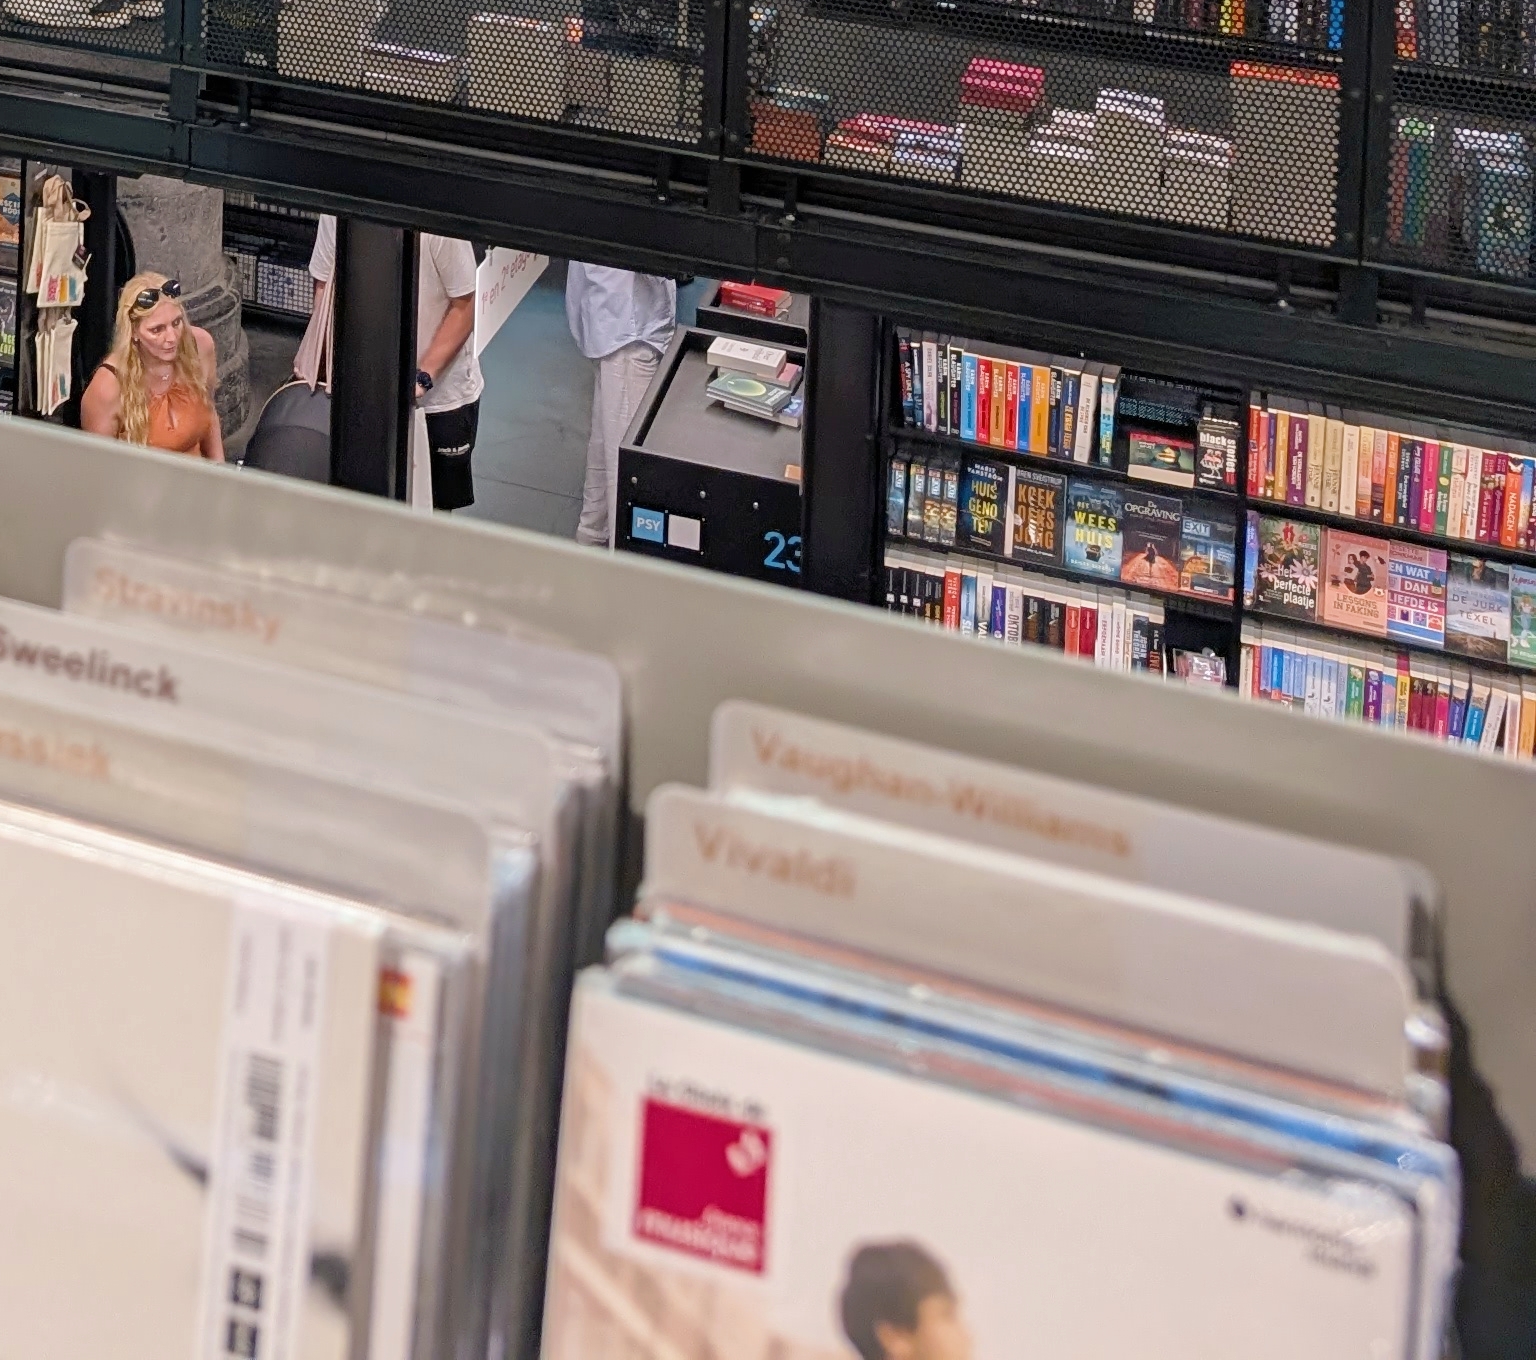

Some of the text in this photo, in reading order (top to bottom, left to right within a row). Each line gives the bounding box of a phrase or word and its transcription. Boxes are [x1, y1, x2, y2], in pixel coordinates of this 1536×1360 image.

[490, 282, 499, 305] en
[1200, 431, 1227, 446] black
[1225, 437, 1237, 474] stories
[971, 479, 998, 498] HUIS
[1018, 483, 1056, 506] KOEK
[968, 501, 998, 518] GENO
[1124, 502, 1181, 522] OPGRAVING
[1147, 499, 1158, 508] De
[1508, 492, 1516, 532] NADAGEN
[636, 516, 660, 532] PSY
[971, 517, 993, 535] TEN
[1074, 511, 1117, 532] WEES
[1183, 519, 1211, 537] EXIT
[1074, 529, 1113, 549] HUIS
[1277, 564, 1293, 579] Het
[1389, 562, 1430, 580] EN WAT
[1273, 579, 1311, 598] perfecte
[1404, 581, 1429, 596] DAN
[91, 564, 281, 644] Stravinsky
[1282, 592, 1315, 609] plaatje
[1333, 600, 1379, 619] IN FAKING
[1336, 594, 1378, 610] LESSONS
[1388, 591, 1439, 613] LIEFDE IS
[1451, 594, 1503, 613] DE JURK
[1458, 611, 1495, 627] TEXEL
[751, 726, 1135, 866] Vaughan-Williams
[692, 816, 858, 902] Vivaldi
